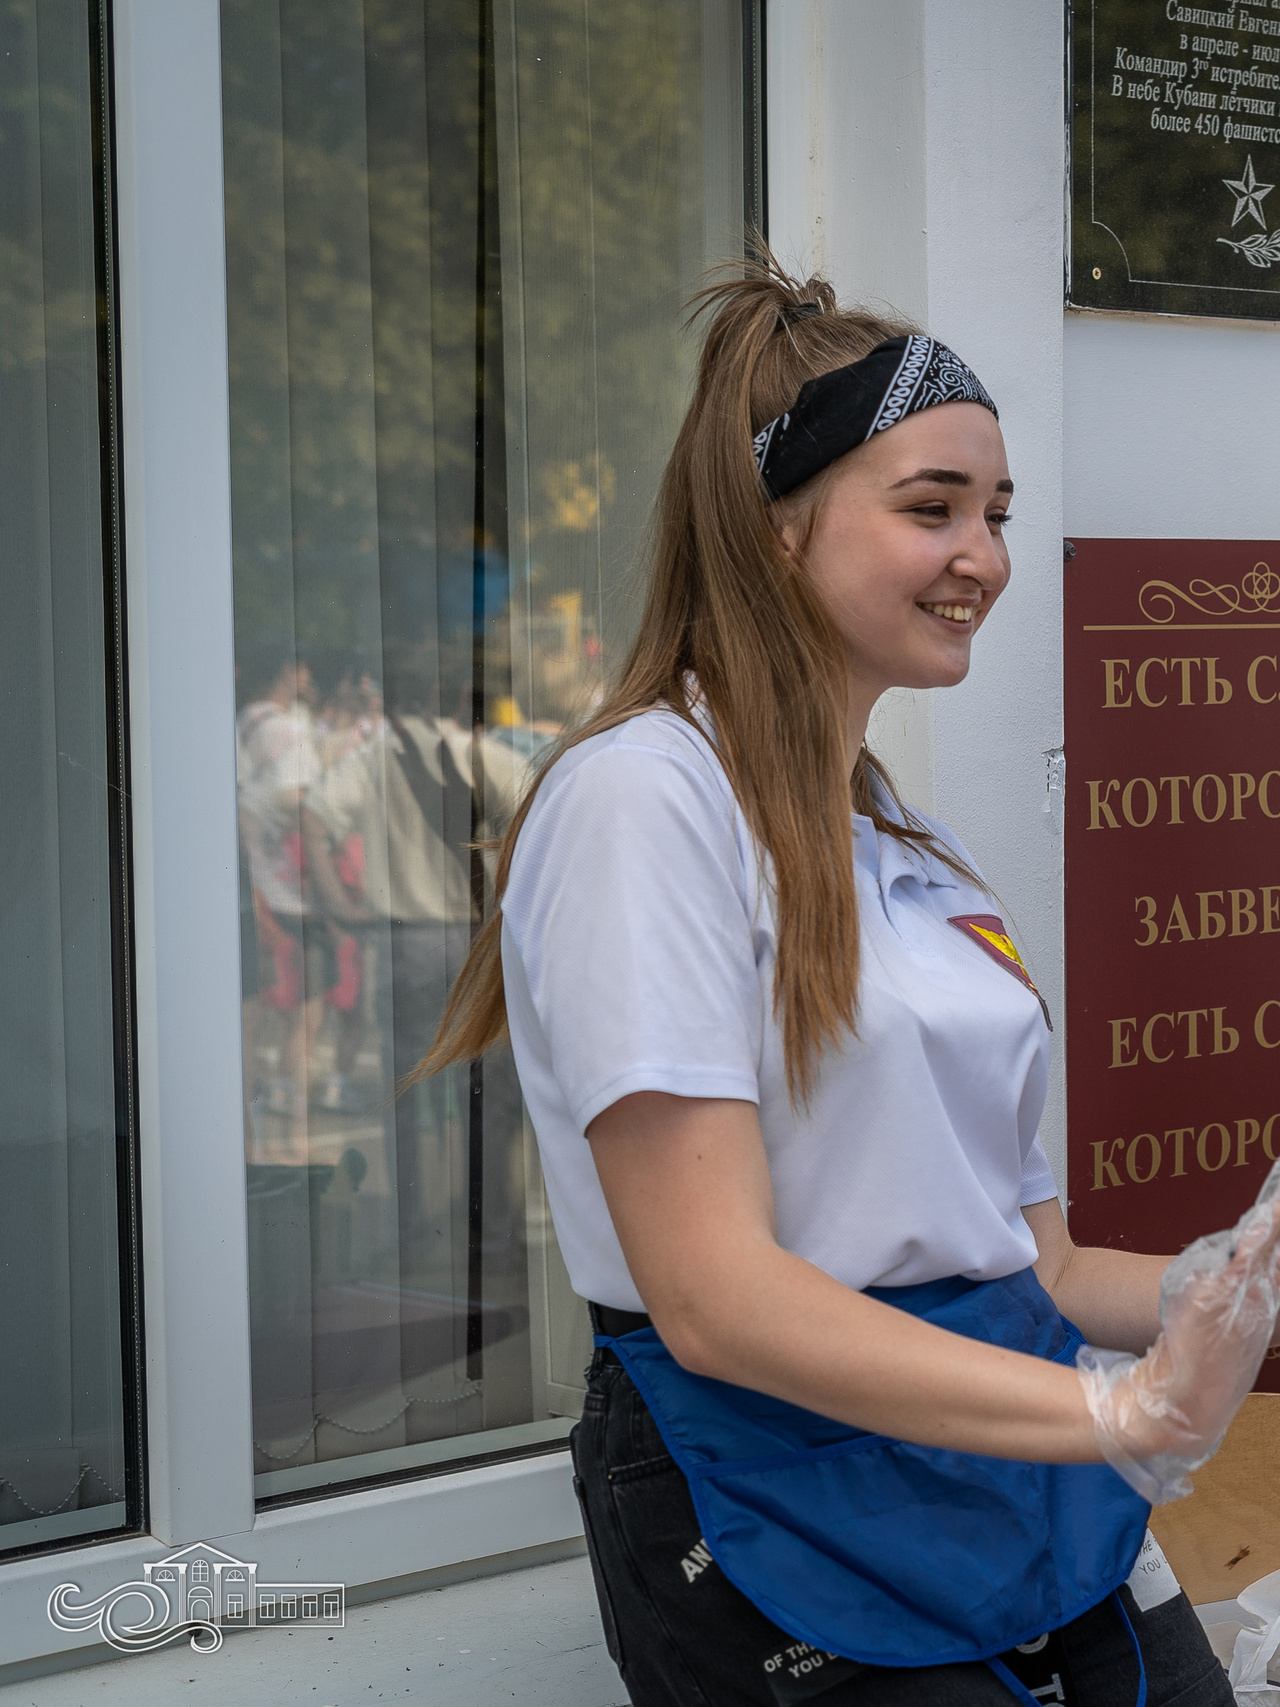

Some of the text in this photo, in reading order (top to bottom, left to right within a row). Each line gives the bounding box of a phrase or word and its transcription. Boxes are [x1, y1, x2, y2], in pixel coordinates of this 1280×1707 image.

[1166, 0, 1235, 29] Савицкий
[1180, 34, 1188, 50] в
[1192, 35, 1239, 59] апреле
[1114, 46, 1187, 83] Командир
[1111, 74, 1123, 97] В
[1127, 78, 1160, 101] небе
[1163, 81, 1217, 110] Кубани
[1219, 90, 1276, 117] лётчики
[1150, 107, 1191, 133] более
[1194, 113, 1220, 136] 450
[1101, 656, 1233, 708] ЕСТЬ
[1107, 1006, 1240, 1069] ЕСТЬ
[1139, 1558, 1161, 1575] YOU
[764, 1653, 783, 1672] OF
[786, 1641, 815, 1659] TH
[788, 1654, 823, 1678] YOU
